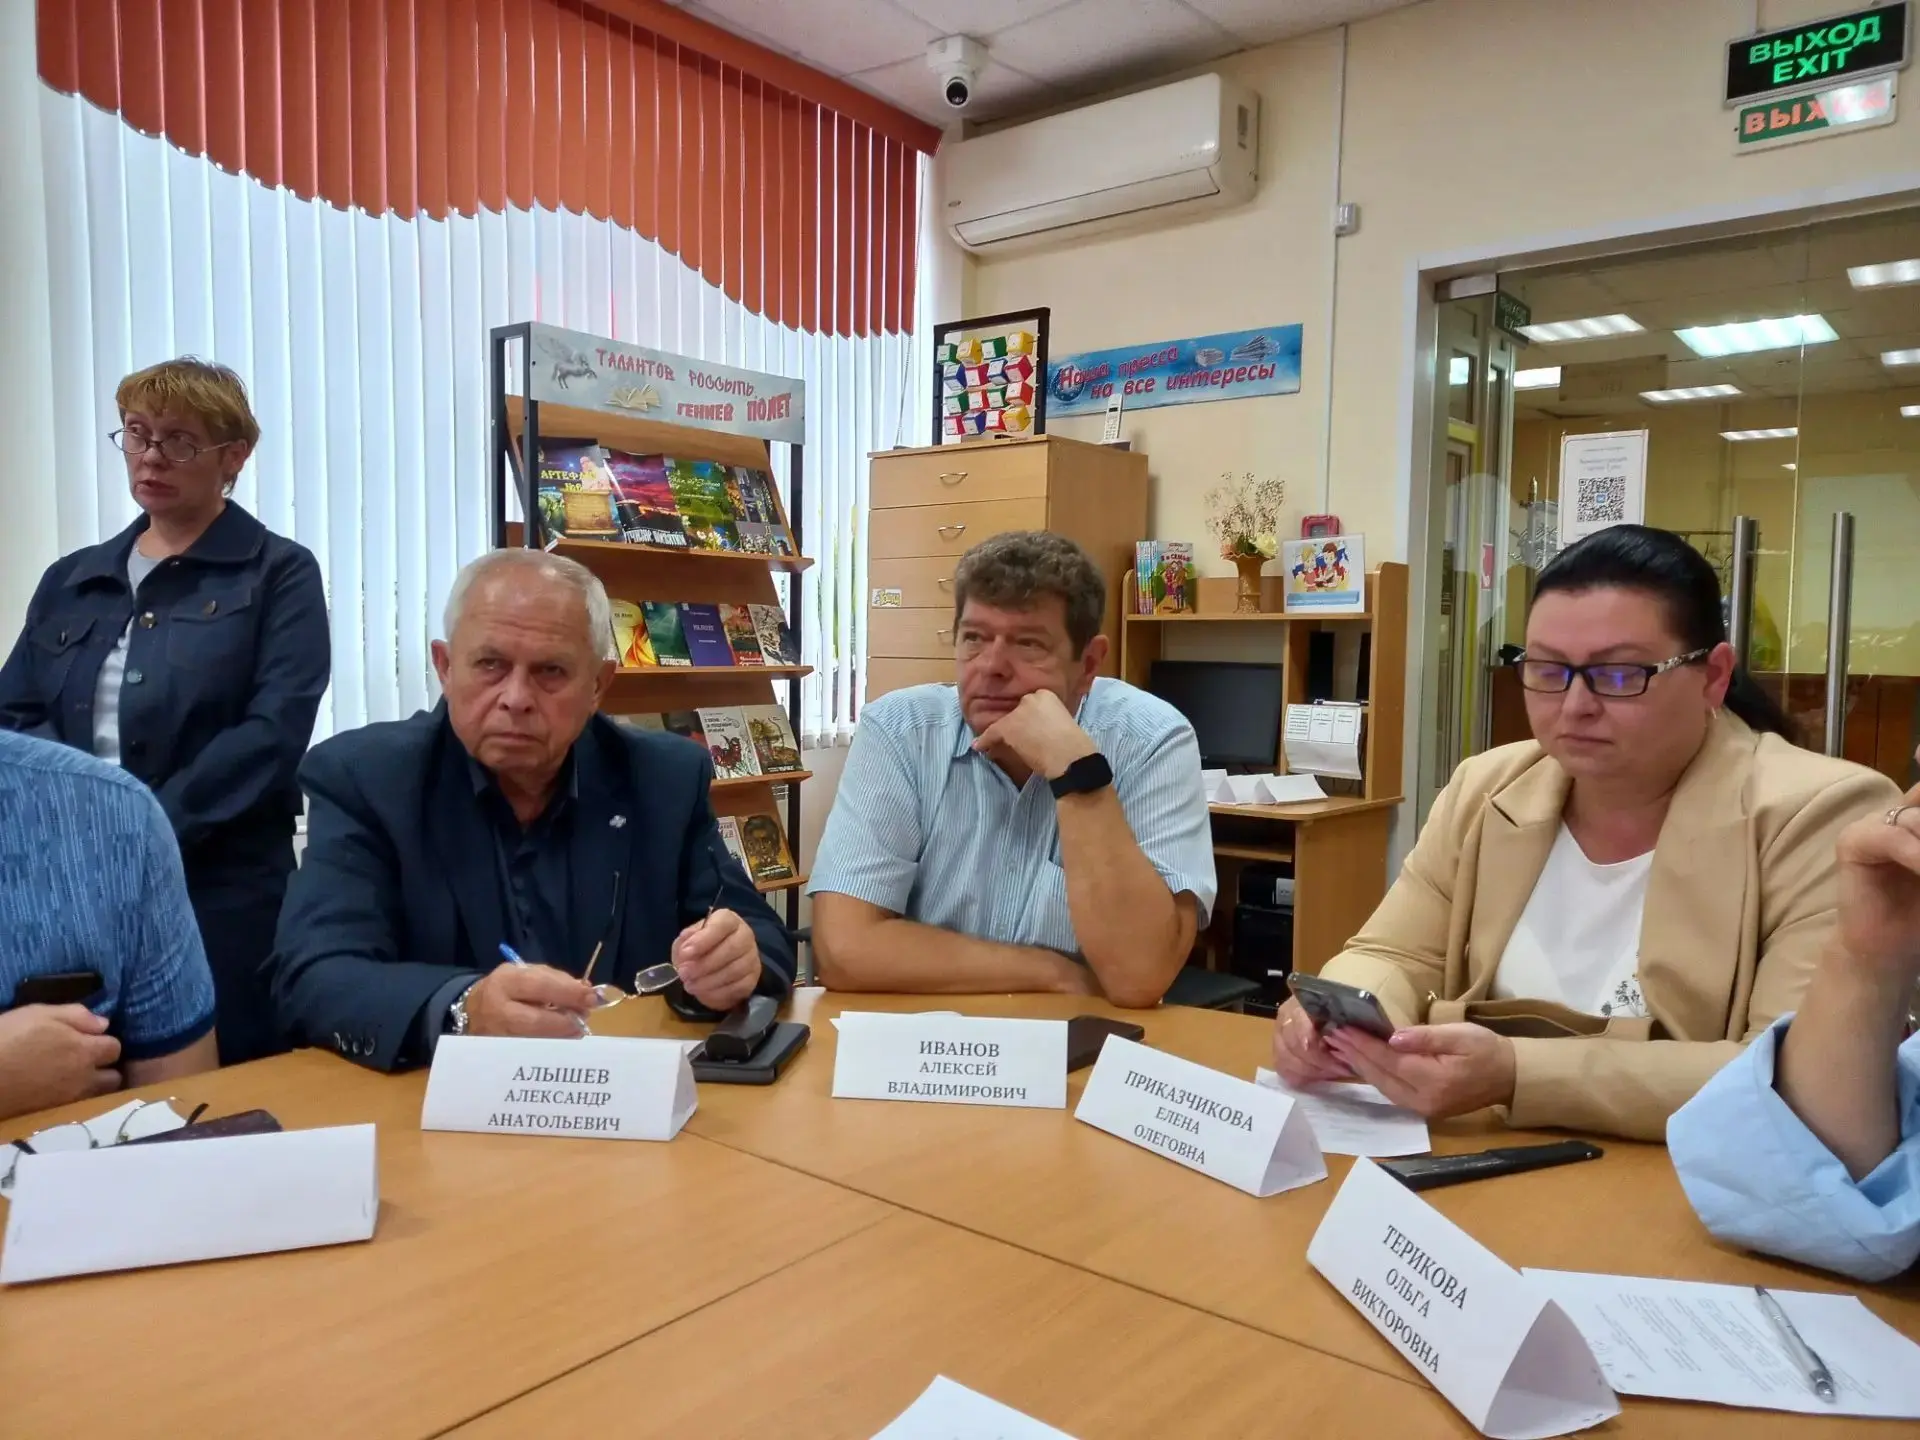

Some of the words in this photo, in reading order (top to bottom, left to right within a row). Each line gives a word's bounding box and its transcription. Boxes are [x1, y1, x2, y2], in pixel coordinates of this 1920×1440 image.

[1749, 15, 1881, 64] ВЫХОД
[1773, 47, 1853, 83] EXIT
[595, 348, 676, 382] ТАЛАНТОВ
[1058, 363, 1110, 390] Наша
[1117, 345, 1179, 379] пресса
[1090, 381, 1113, 400] на
[1123, 378, 1156, 396] все
[1166, 363, 1277, 391] интересы
[676, 402, 734, 422] ГЕНИЕВ
[919, 1040, 1000, 1058] ИВАНОВ
[512, 1066, 610, 1085] АЛЫШЕВ
[919, 1061, 997, 1077] АЛЕКСЕЙ
[504, 1089, 612, 1107] АЛЕКСАНДР
[888, 1081, 1027, 1100] ВЛАДИМИРОВИЧ
[1124, 1070, 1254, 1132] ПРИКАЗЧИКОВА
[487, 1112, 621, 1132] АНАТОЛЬЕВИЧ
[1155, 1106, 1200, 1135] ЕЛЕНА
[1134, 1124, 1205, 1165] ОЛЕГОВНА
[1382, 1224, 1469, 1312] ТЕРИКОВА
[1386, 1268, 1431, 1318] ОЛЬГА
[1351, 1277, 1440, 1374] ВИКТОРОВНА
